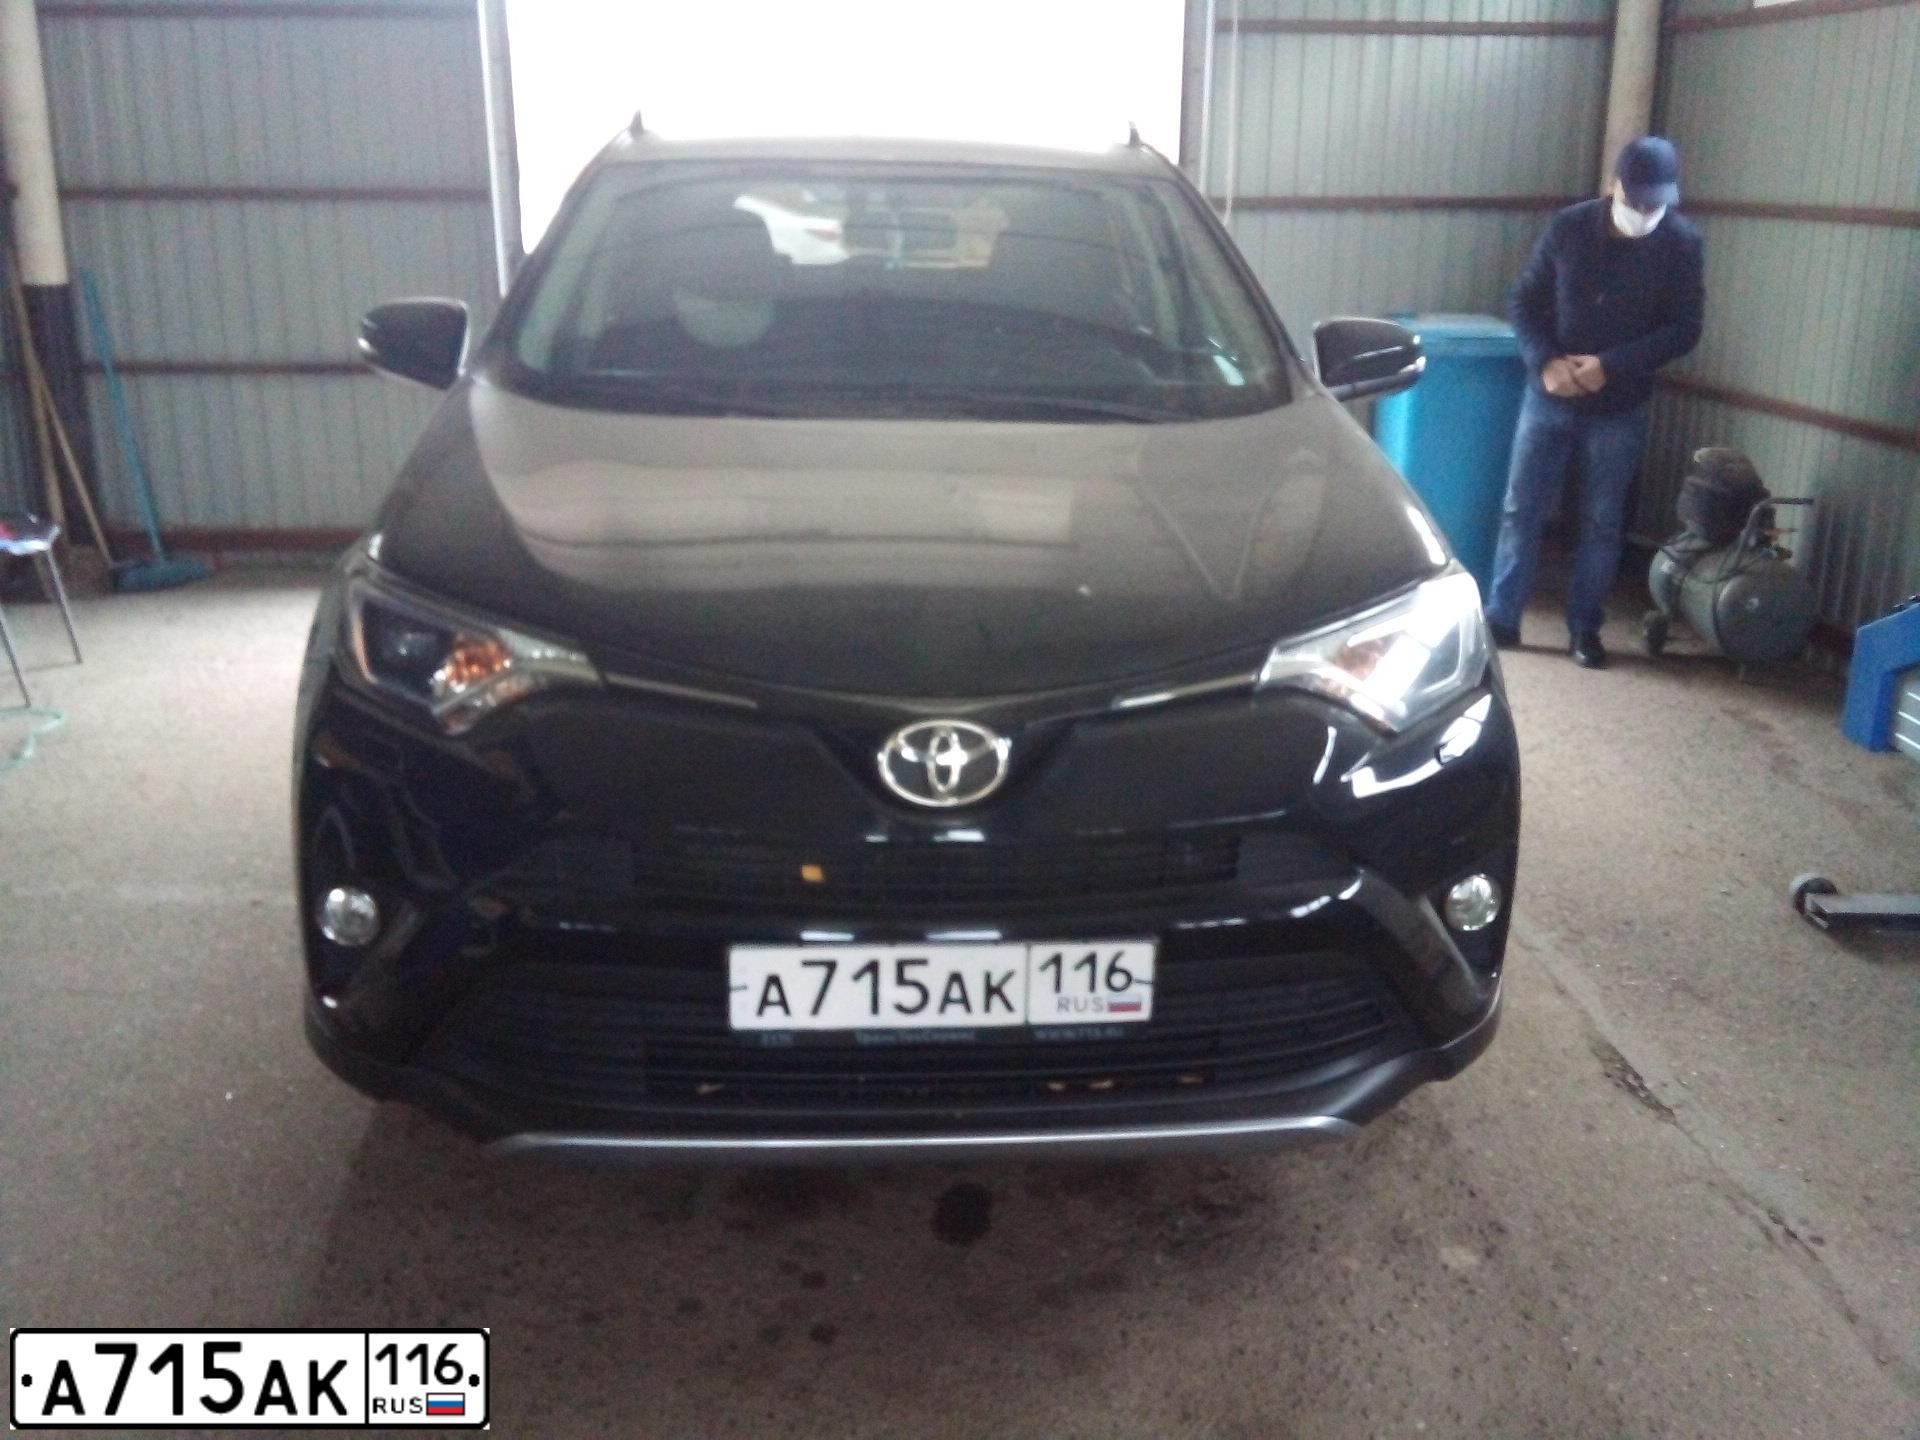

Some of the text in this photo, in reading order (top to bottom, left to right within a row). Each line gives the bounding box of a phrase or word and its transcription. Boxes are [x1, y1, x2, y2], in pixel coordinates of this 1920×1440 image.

[756, 951, 1133, 1017] A715AK 116
[1057, 997, 1105, 1013] RUS
